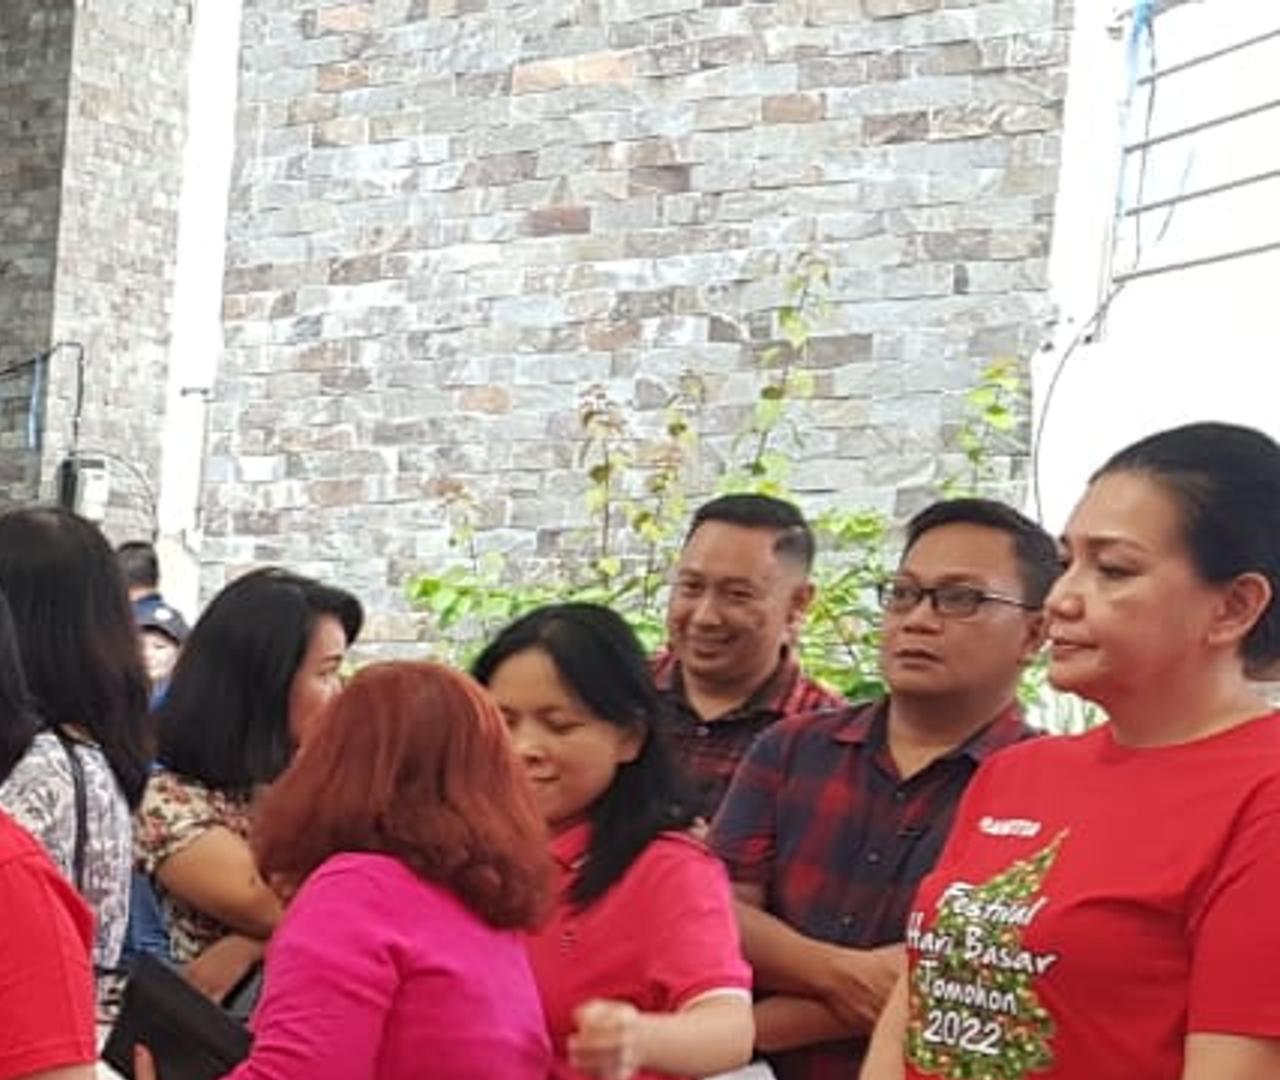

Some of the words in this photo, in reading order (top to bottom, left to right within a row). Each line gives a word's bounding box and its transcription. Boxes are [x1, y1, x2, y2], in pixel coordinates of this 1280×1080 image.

[935, 881, 1048, 927] Festival
[907, 911, 954, 956] Hari
[919, 959, 1018, 1014] Tomohon
[923, 1010, 1001, 1056] 2022
